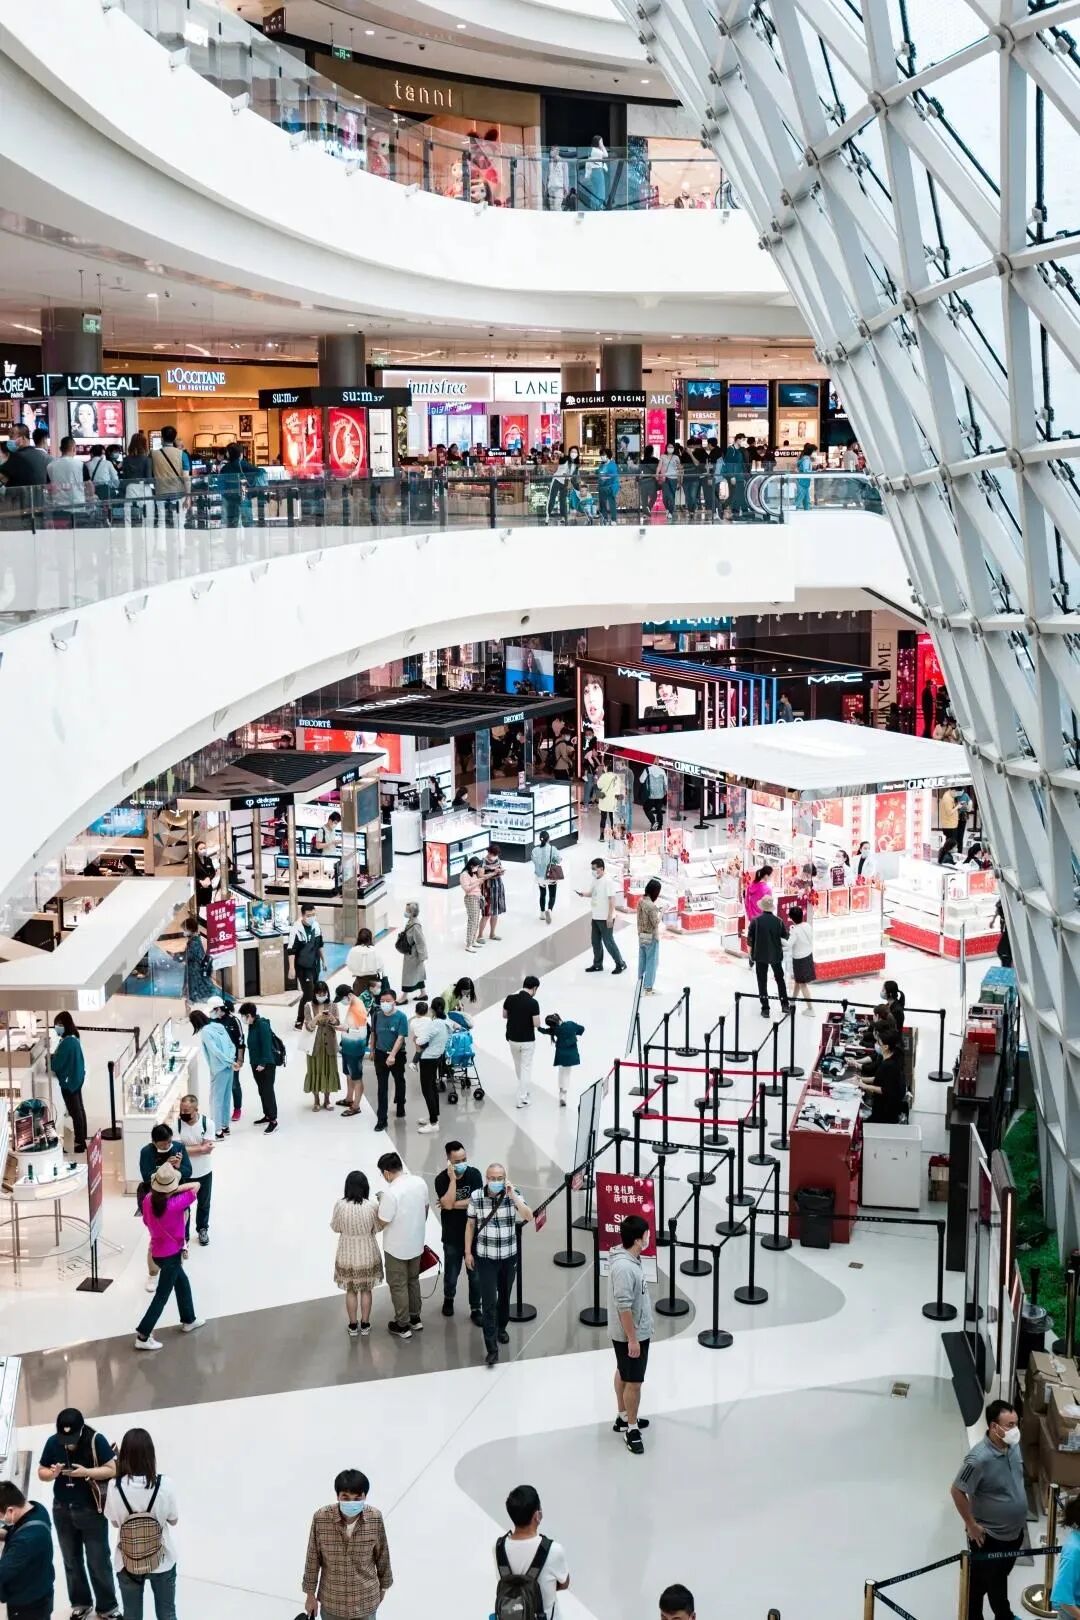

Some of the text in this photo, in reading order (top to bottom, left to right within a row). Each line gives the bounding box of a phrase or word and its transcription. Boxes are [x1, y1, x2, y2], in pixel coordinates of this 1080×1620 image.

[67, 374, 140, 391] L'ORÉAL
[167, 367, 226, 385] L'OCCITANE
[408, 379, 468, 395] innisfree
[576, 396, 605, 404] ORIGINS
[650, 394, 672, 405] AHC
